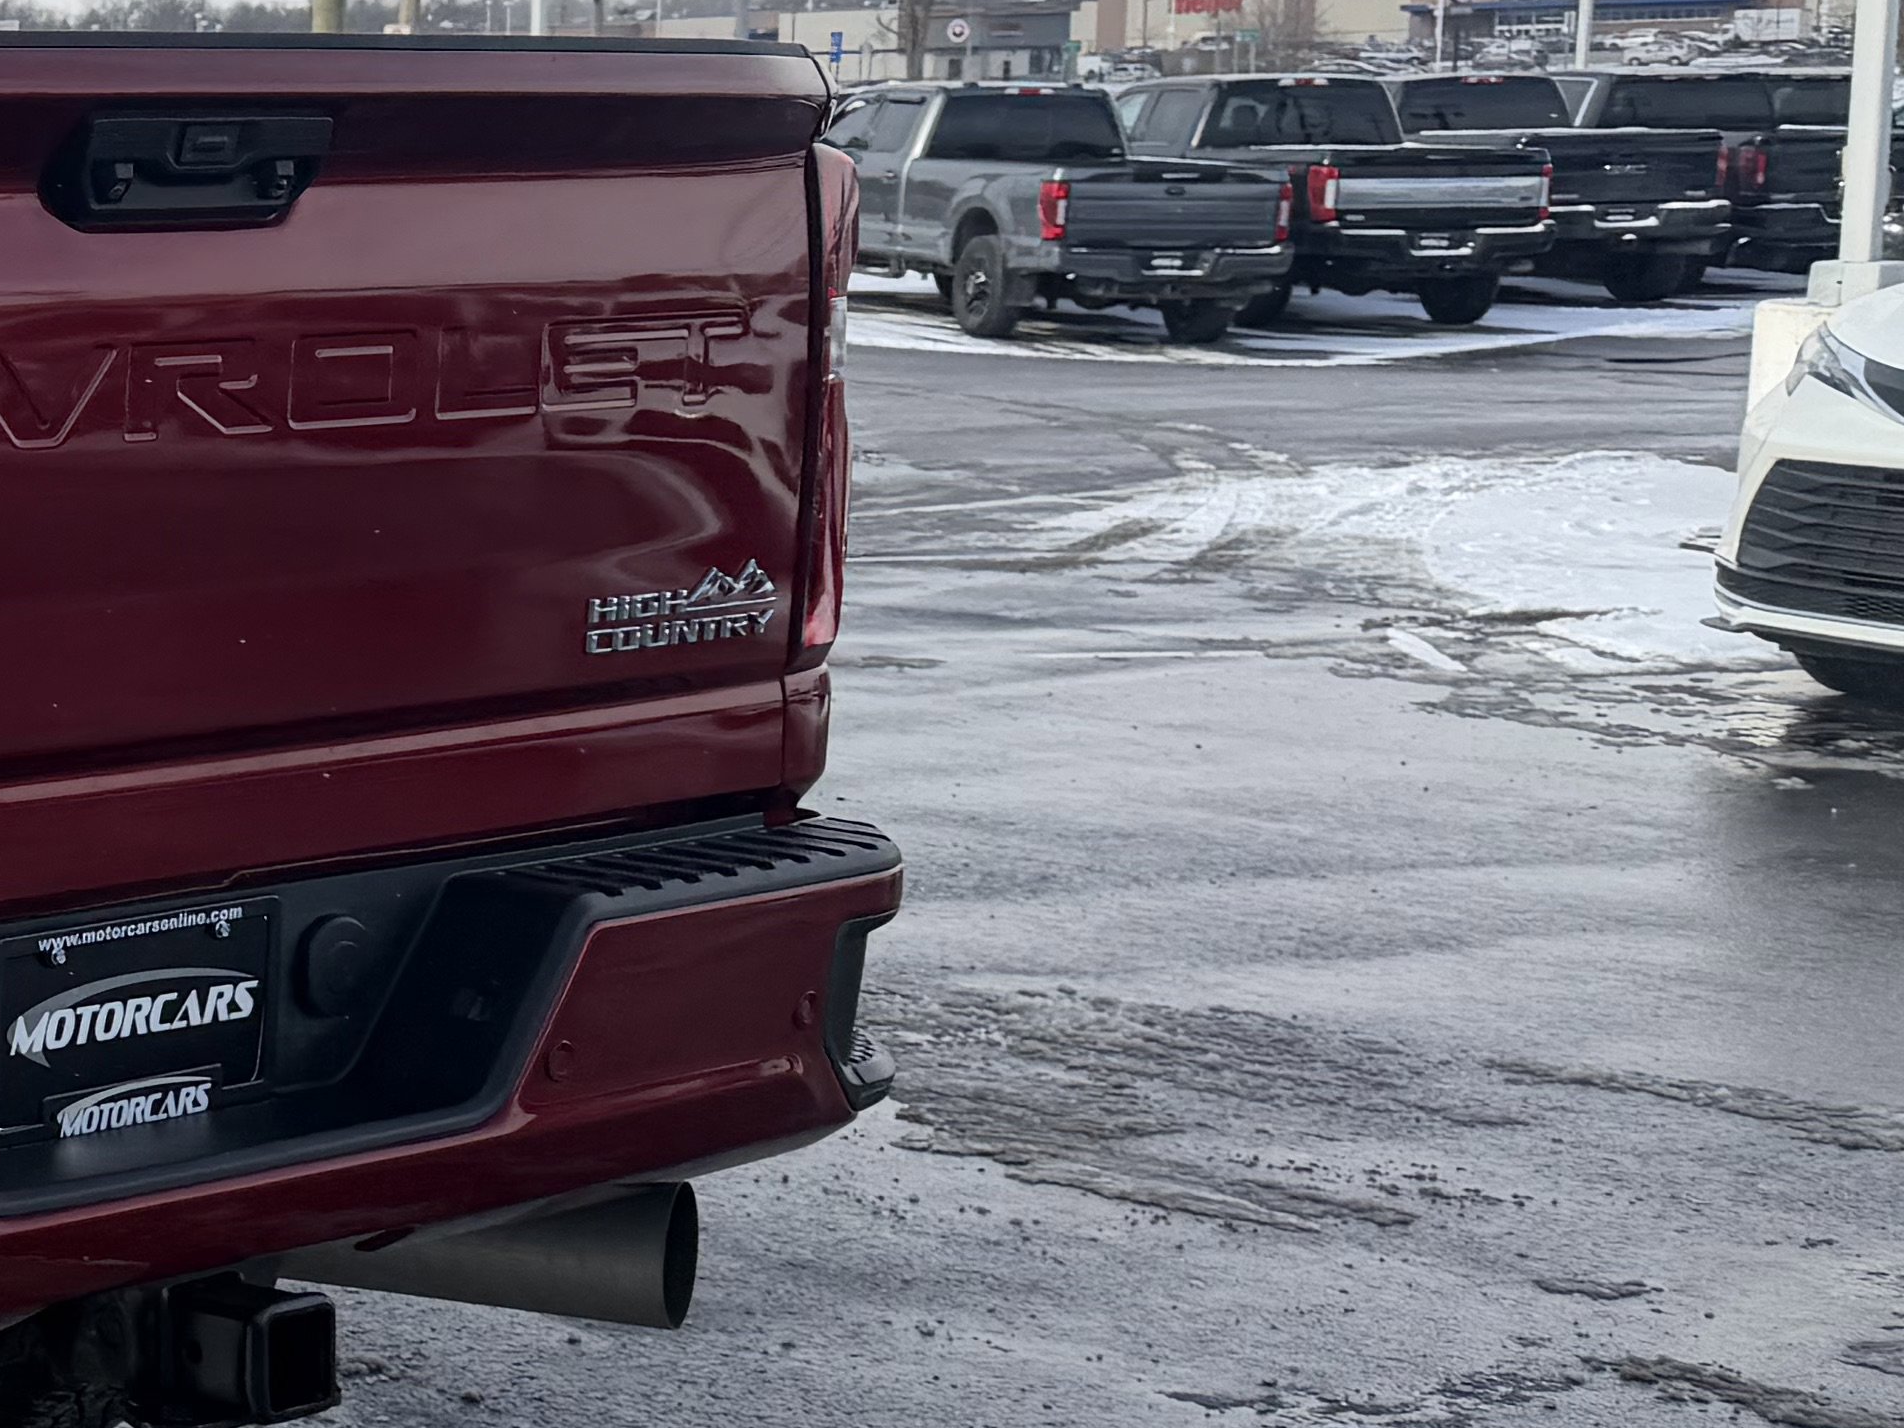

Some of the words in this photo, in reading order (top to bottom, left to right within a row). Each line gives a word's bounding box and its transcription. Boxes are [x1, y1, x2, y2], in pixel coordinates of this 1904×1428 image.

[588, 588, 690, 623] HIGH
[585, 608, 775, 654] COUNTRY
[37, 904, 243, 952] www.motorcarsonline.com
[9, 979, 259, 1057] MOTORCARS
[59, 1082, 212, 1139] MOTORCARS
